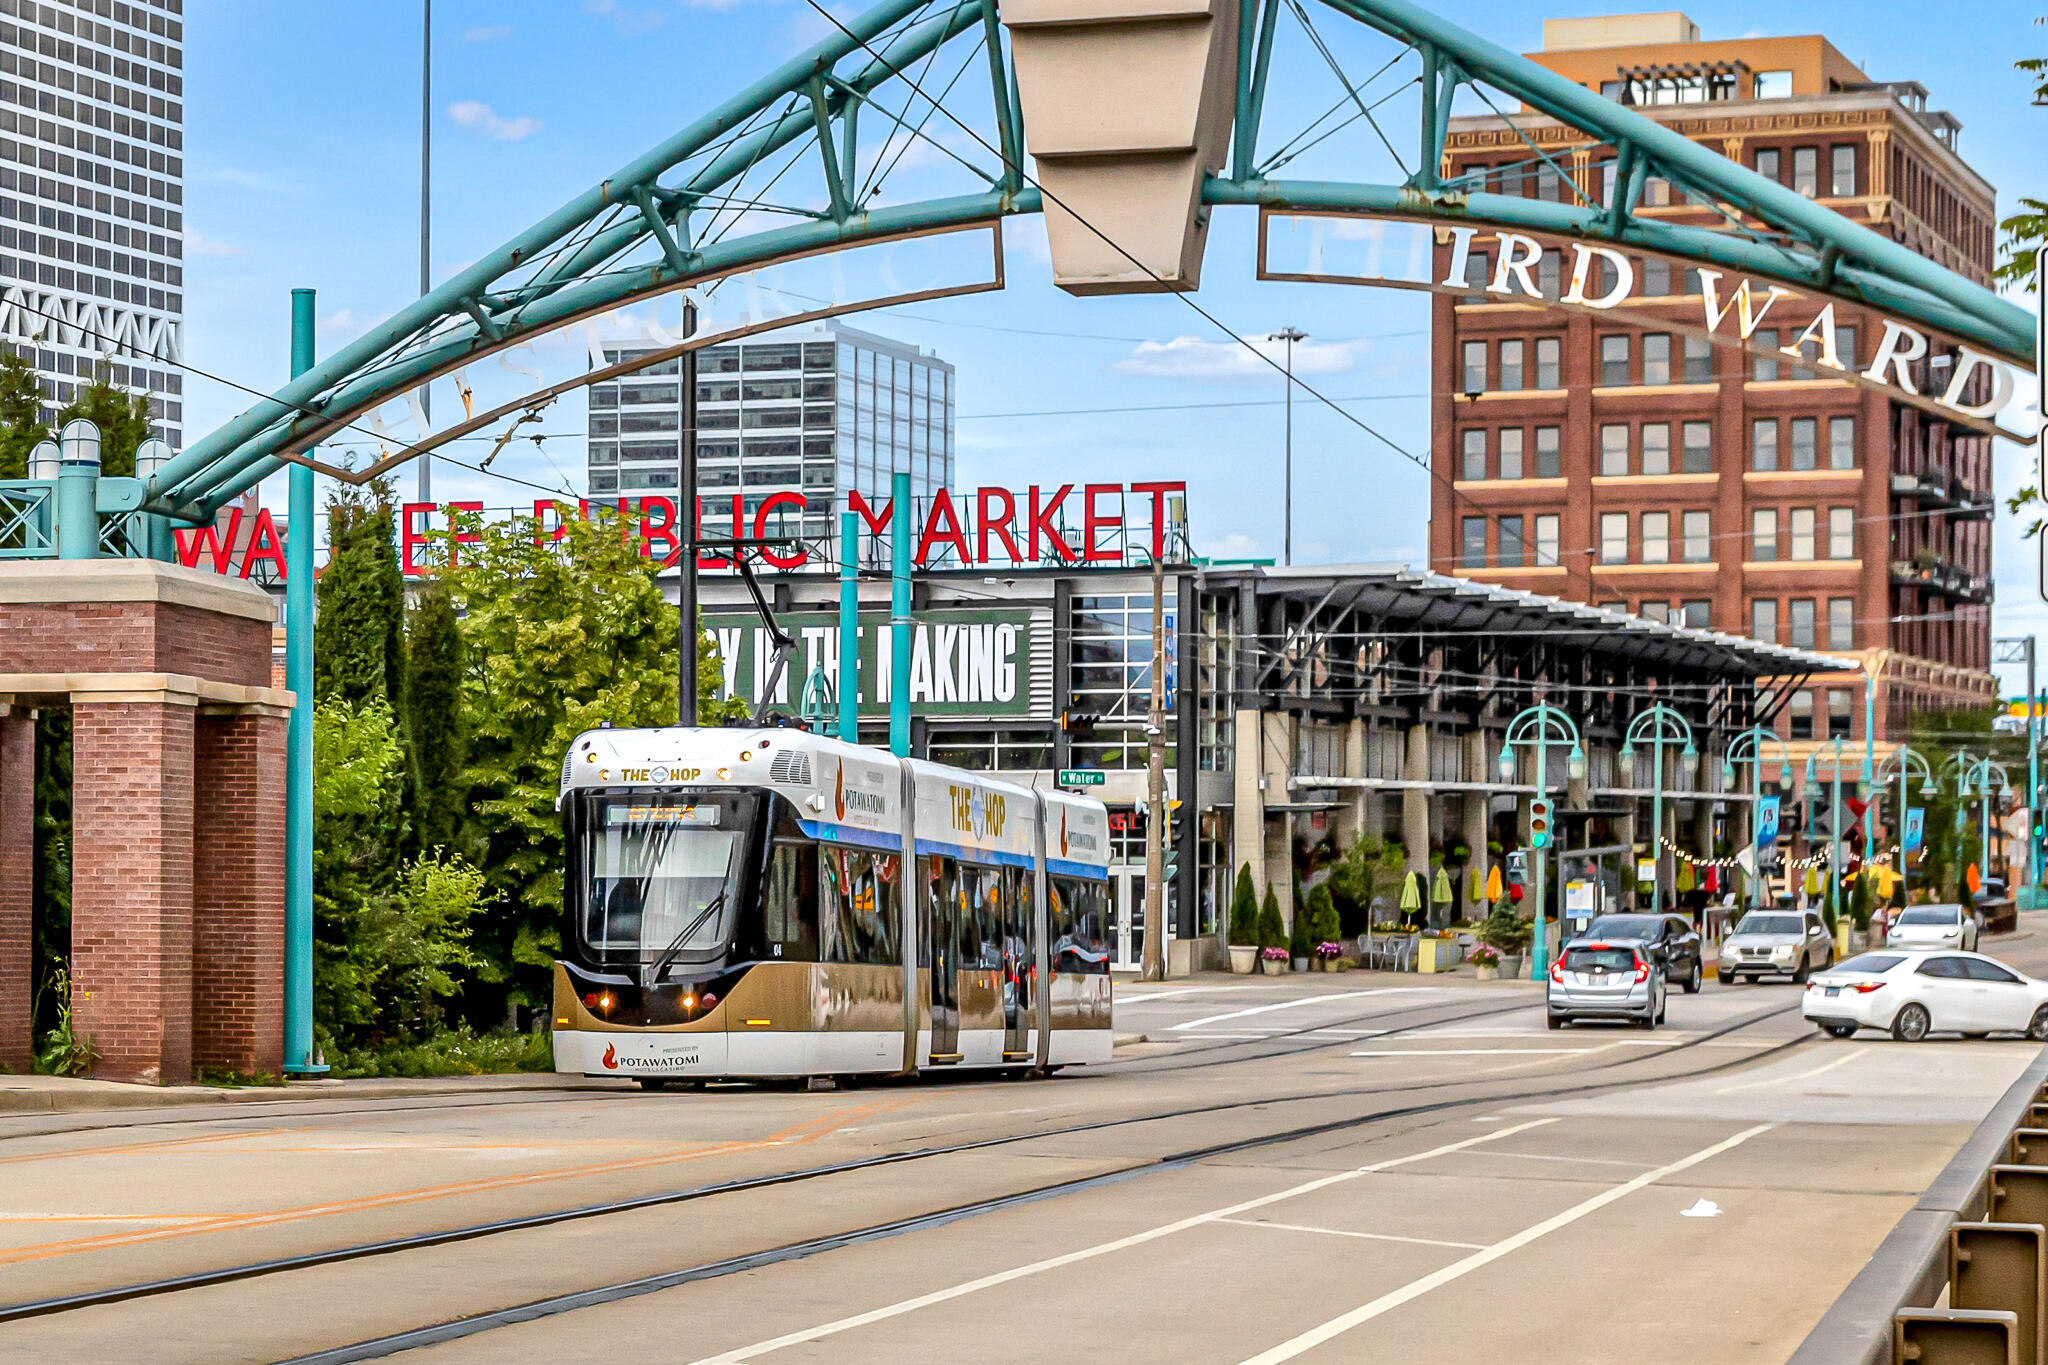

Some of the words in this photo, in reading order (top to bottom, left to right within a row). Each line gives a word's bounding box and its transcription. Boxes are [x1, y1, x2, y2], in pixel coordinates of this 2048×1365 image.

[1291, 215, 1634, 310] THIRD
[1696, 267, 2015, 419] WARD
[848, 481, 1187, 565] MARKET
[753, 626, 789, 704] IN
[801, 626, 863, 704] TH
[621, 768, 651, 782] THE
[670, 768, 701, 781] HOP
[1068, 772, 1095, 784] Water
[949, 785, 972, 832] THE
[985, 792, 1006, 837] HOP
[620, 1055, 699, 1067] POTAWATOMI
